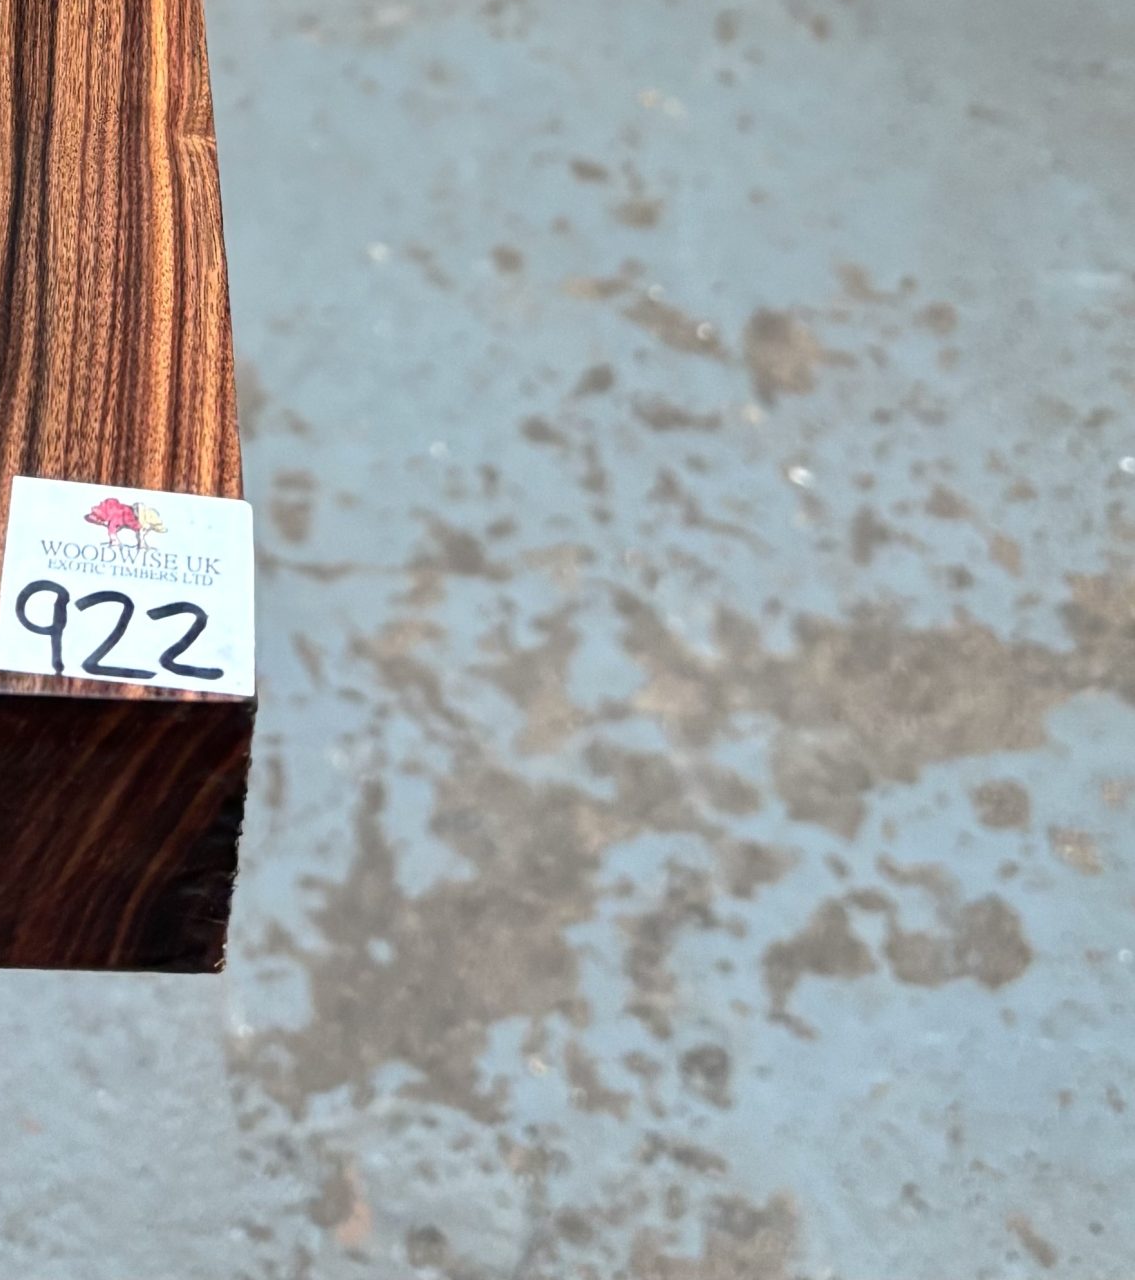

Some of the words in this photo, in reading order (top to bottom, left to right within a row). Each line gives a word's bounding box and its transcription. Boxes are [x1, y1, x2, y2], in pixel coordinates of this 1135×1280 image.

[41, 539, 178, 571] WOODWISE
[187, 556, 221, 575] UK
[47, 558, 105, 575] EXOTIC
[111, 565, 178, 583] TIMBERS
[182, 572, 214, 587] LTD
[15, 579, 225, 680] 922
